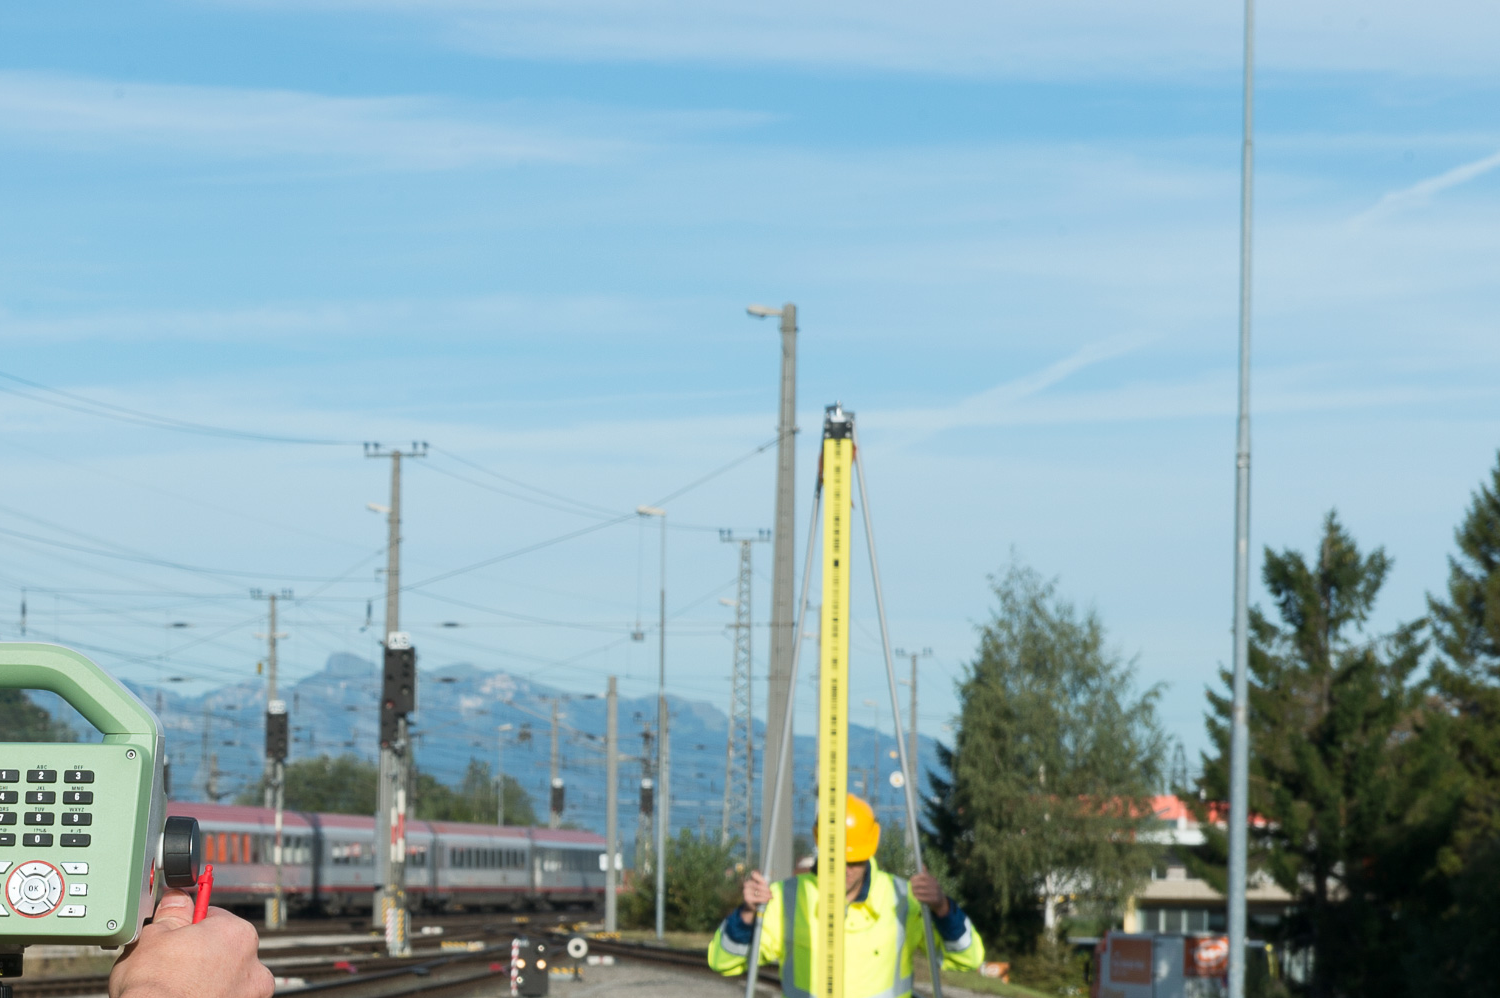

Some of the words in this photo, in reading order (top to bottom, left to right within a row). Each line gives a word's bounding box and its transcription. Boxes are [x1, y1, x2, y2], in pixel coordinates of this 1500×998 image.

[1, 771, 7, 779] 1
[38, 771, 44, 779] 2
[75, 772, 81, 780] 3
[0, 792, 5, 800] 4
[37, 792, 43, 801] 5
[74, 793, 80, 801] 6
[36, 813, 41, 821] 8
[73, 814, 78, 822] 9
[34, 835, 40, 843] 0
